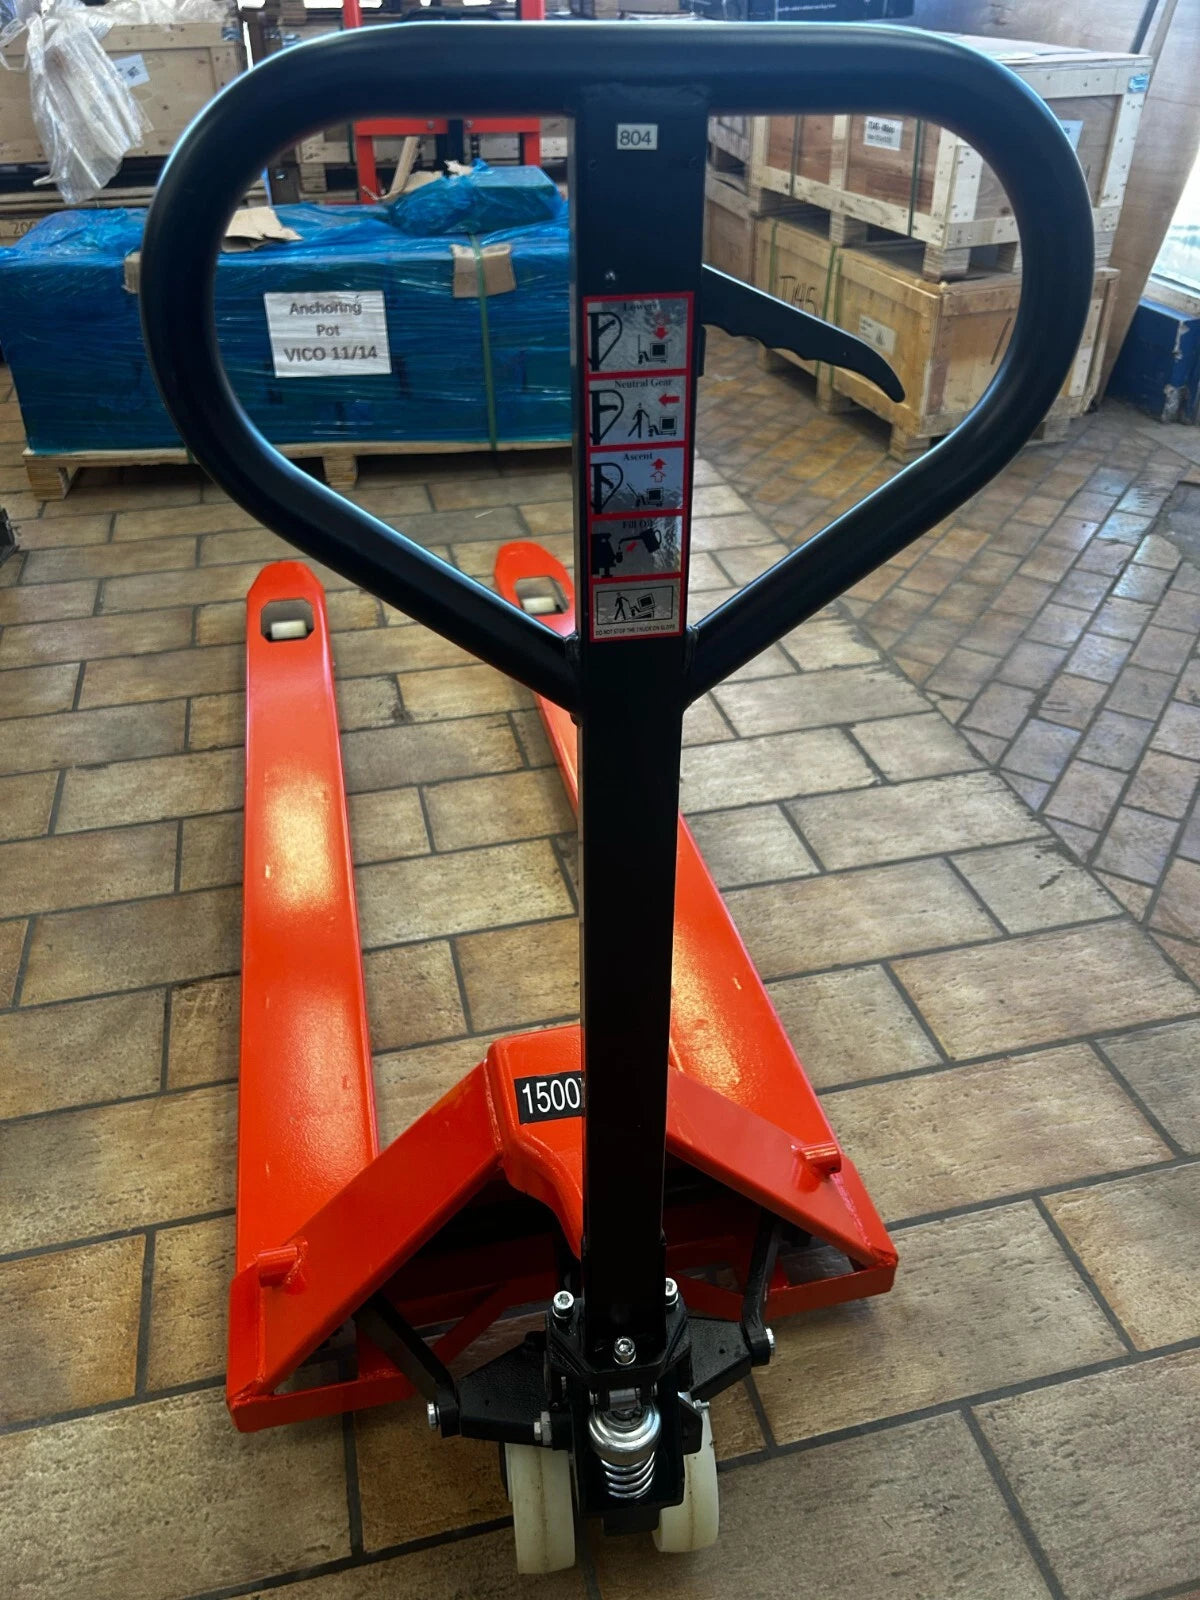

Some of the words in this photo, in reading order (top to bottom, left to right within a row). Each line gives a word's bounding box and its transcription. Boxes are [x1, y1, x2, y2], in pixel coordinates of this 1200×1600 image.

[620, 130, 652, 146] 804
[289, 300, 362, 316] Anchoring
[316, 324, 340, 336] Pot
[284, 347, 326, 362] VICO
[331, 345, 378, 360] 11/14
[614, 379, 648, 389] Neutral
[651, 378, 672, 388] Gear
[623, 453, 653, 461] Ascent
[522, 1077, 585, 1114] 1500
